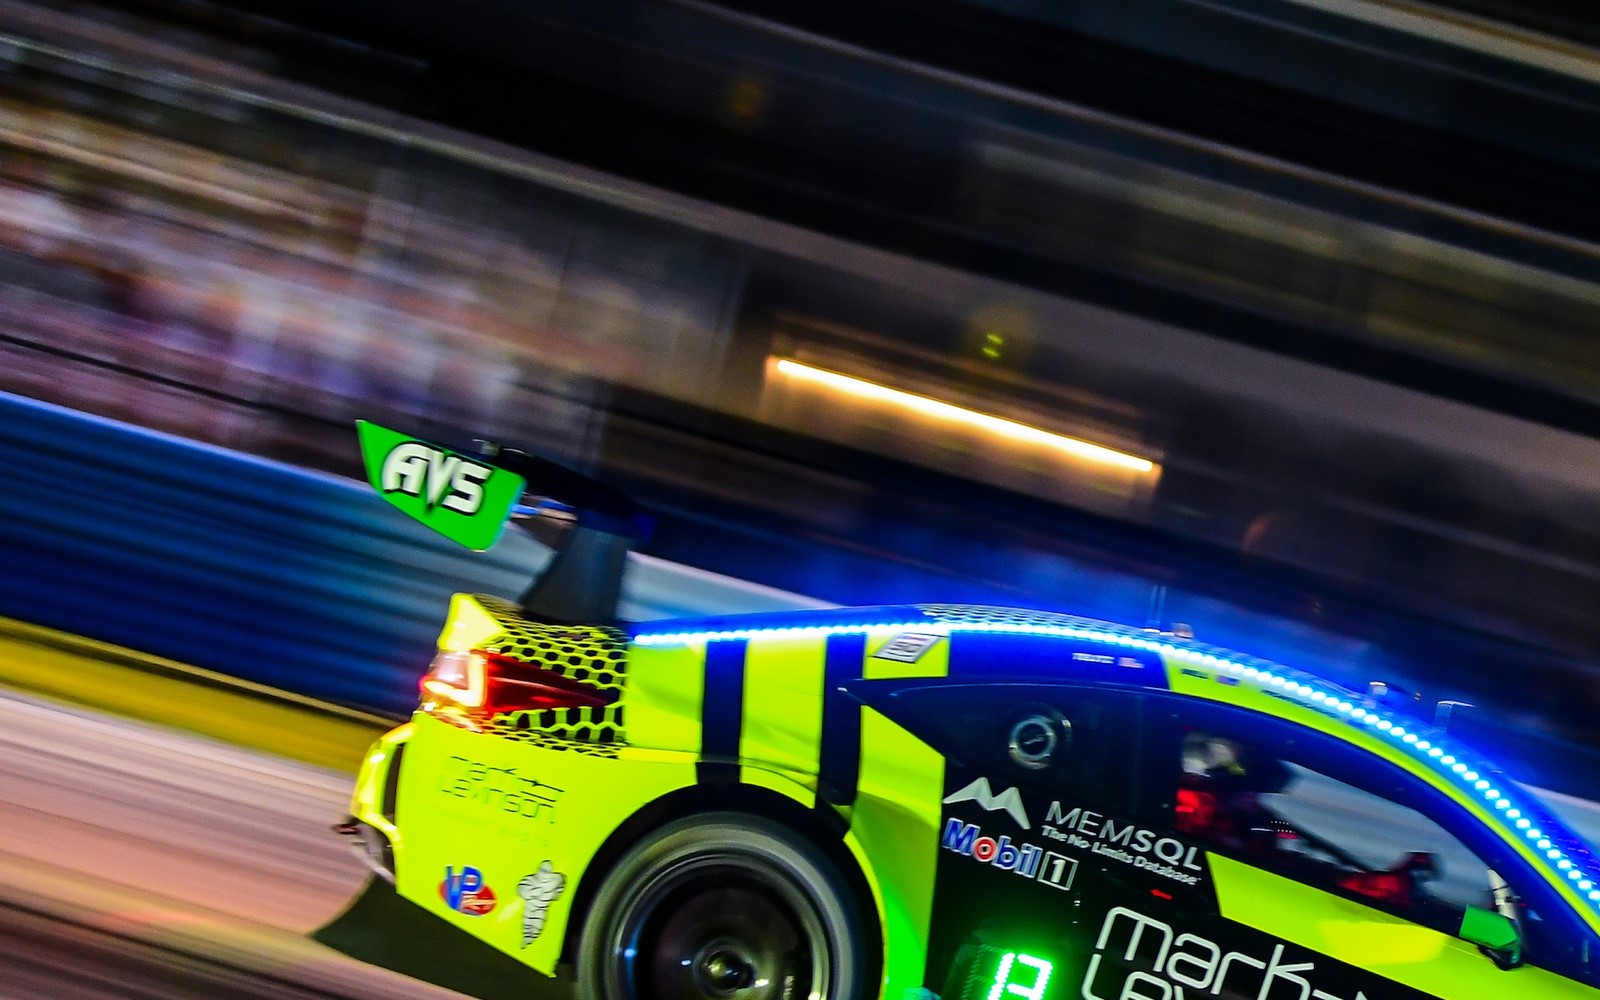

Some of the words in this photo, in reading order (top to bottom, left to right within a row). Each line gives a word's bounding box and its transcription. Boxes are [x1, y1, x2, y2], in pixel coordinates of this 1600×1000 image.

[381, 441, 493, 516] AVS
[941, 817, 1044, 879] Mobil
[1041, 824, 1068, 843] The
[1044, 800, 1202, 872] MEMSQL
